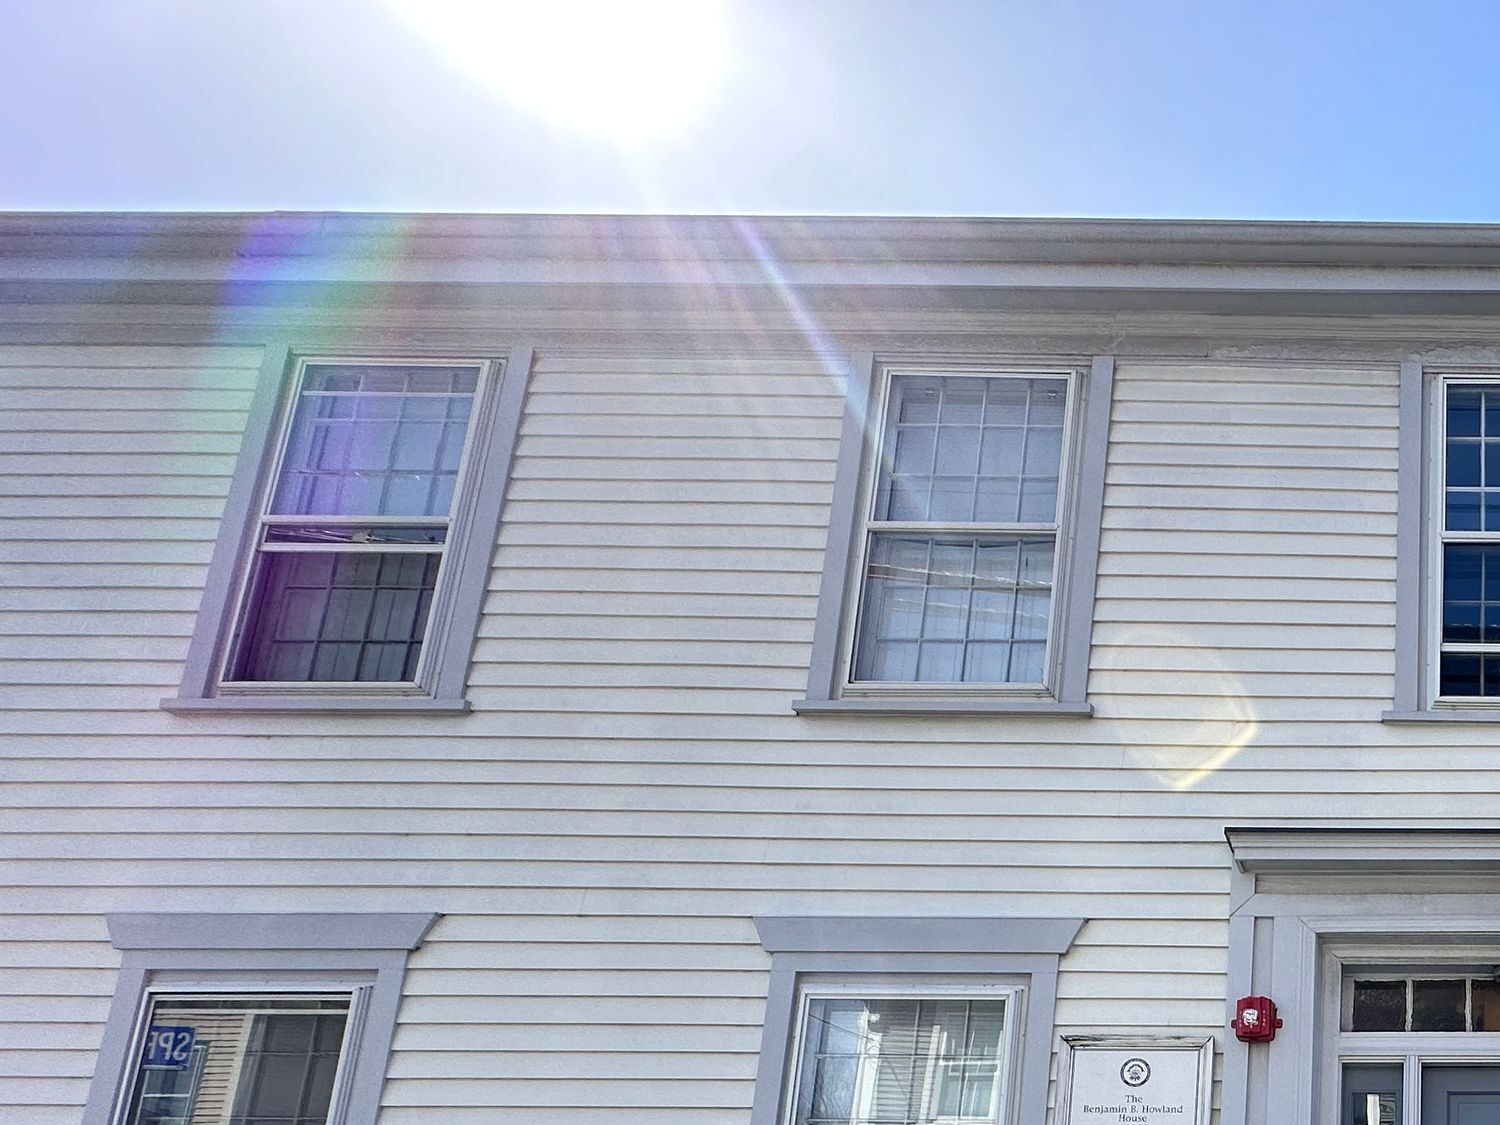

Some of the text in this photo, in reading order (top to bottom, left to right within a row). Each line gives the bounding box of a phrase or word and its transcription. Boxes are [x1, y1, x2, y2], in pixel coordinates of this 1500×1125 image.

[1125, 1095, 1143, 1103] The
[1083, 1105, 1183, 1115] Benjamin B. Howland
[1118, 1114, 1147, 1122] House
